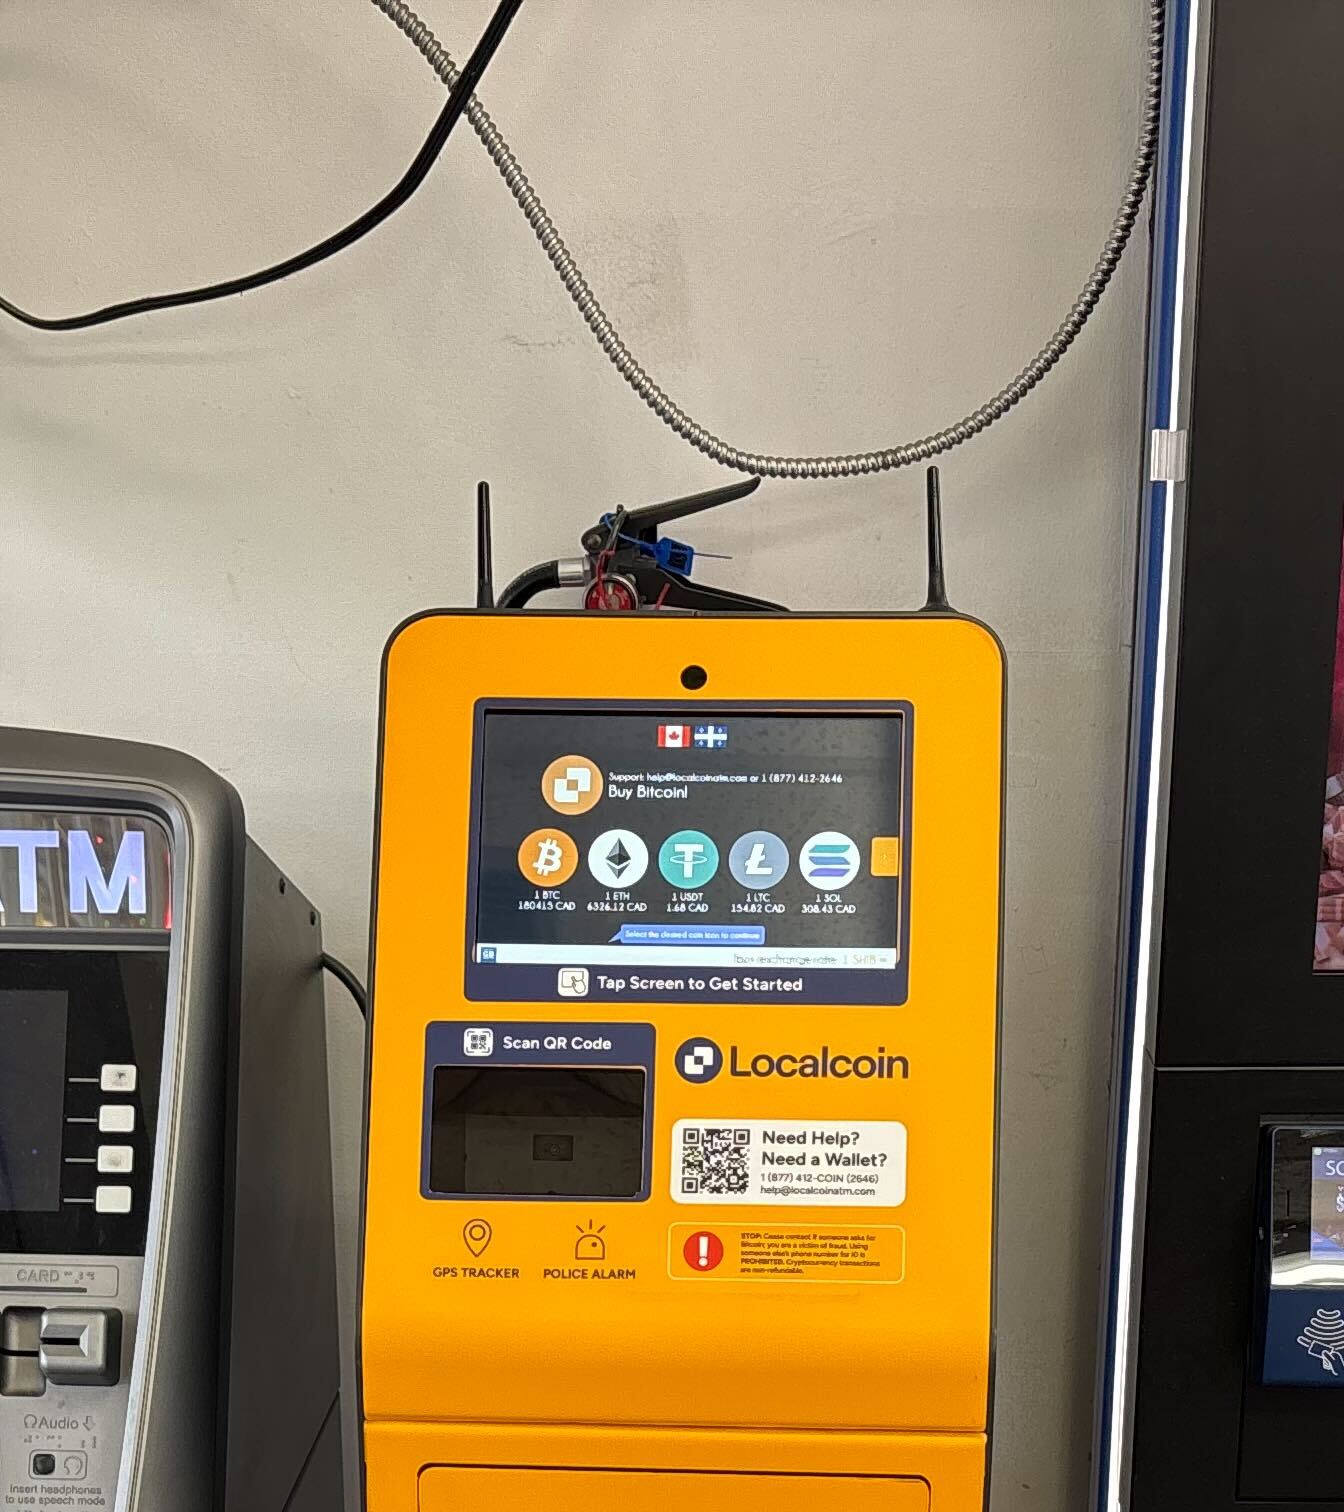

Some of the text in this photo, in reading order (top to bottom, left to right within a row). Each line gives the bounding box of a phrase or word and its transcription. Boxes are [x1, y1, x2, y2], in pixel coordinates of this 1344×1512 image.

[769, 773, 842, 783] (877) 412-2646
[608, 784, 633, 800] Buy
[627, 903, 647, 911] CAD
[836, 905, 856, 913] CAD
[597, 976, 803, 992] Tap Screen to Get Started
[503, 1036, 612, 1051] Scan QR Code
[730, 1046, 909, 1079] Localcoin
[763, 1131, 859, 1147] Need Help?
[762, 1152, 887, 1167] Need a Wallet?
[768, 1173, 793, 1183] (877)
[796, 1174, 843, 1183] 412-COIN
[847, 1174, 878, 1184] (2646)
[761, 1186, 875, 1196] help@localcoinatm.com
[16, 1268, 60, 1283] CARD
[433, 1268, 520, 1279] GPS TRACKER
[543, 1269, 636, 1280] POLICE ALARM
[39, 1416, 79, 1429] Audio
[41, 1485, 102, 1496] headphones
[6, 1495, 105, 1506] to use speech mode
